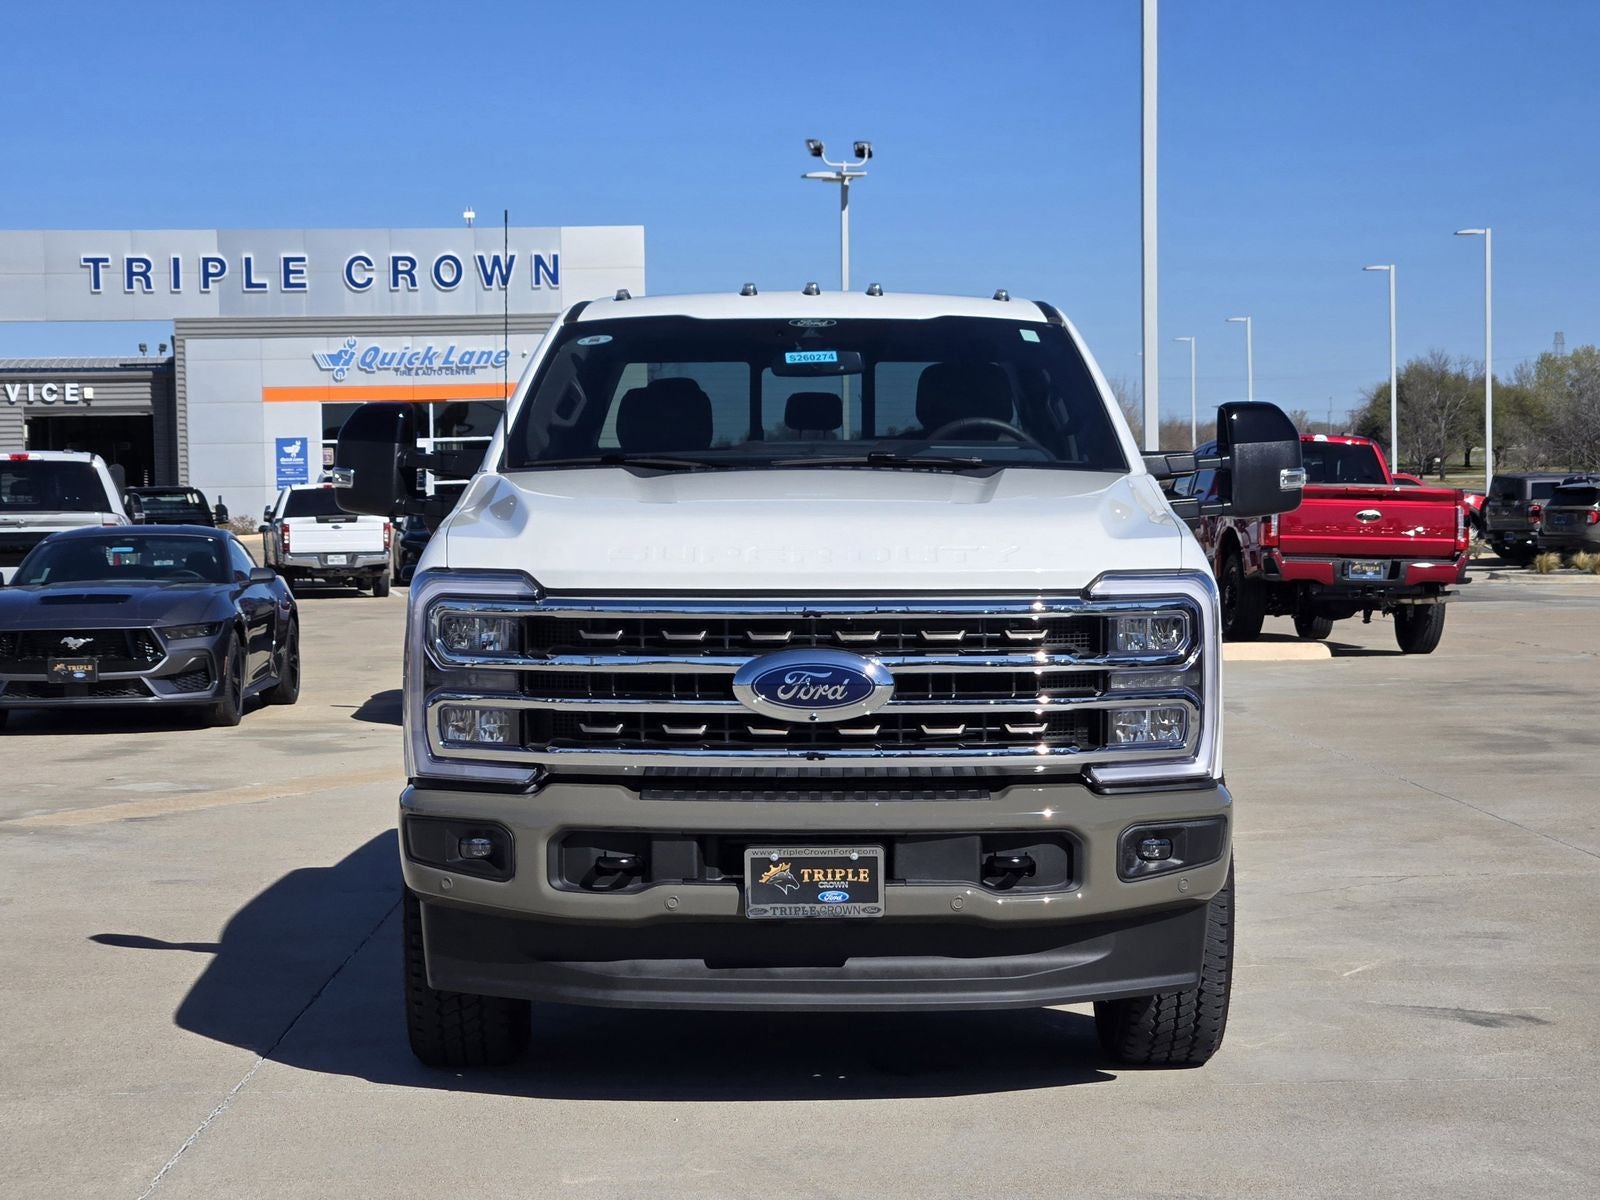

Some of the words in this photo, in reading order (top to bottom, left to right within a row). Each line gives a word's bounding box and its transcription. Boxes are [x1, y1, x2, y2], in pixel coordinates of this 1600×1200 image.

[81, 254, 308, 292] TRIPLE
[344, 253, 560, 290] CROWN
[359, 345, 440, 371] Quick
[441, 344, 510, 368] Lane
[394, 367, 413, 376] TIRE
[421, 367, 443, 376] AUTO
[444, 367, 476, 375] CENTER
[5, 383, 79, 402] VICE
[777, 670, 851, 700] Ford
[751, 848, 878, 857] wwwTripleCrownFordcom
[800, 868, 870, 883] TRIPLE
[818, 881, 849, 889] CROWN
[770, 906, 817, 916] TRIPLE
[819, 905, 861, 915] CROWN
